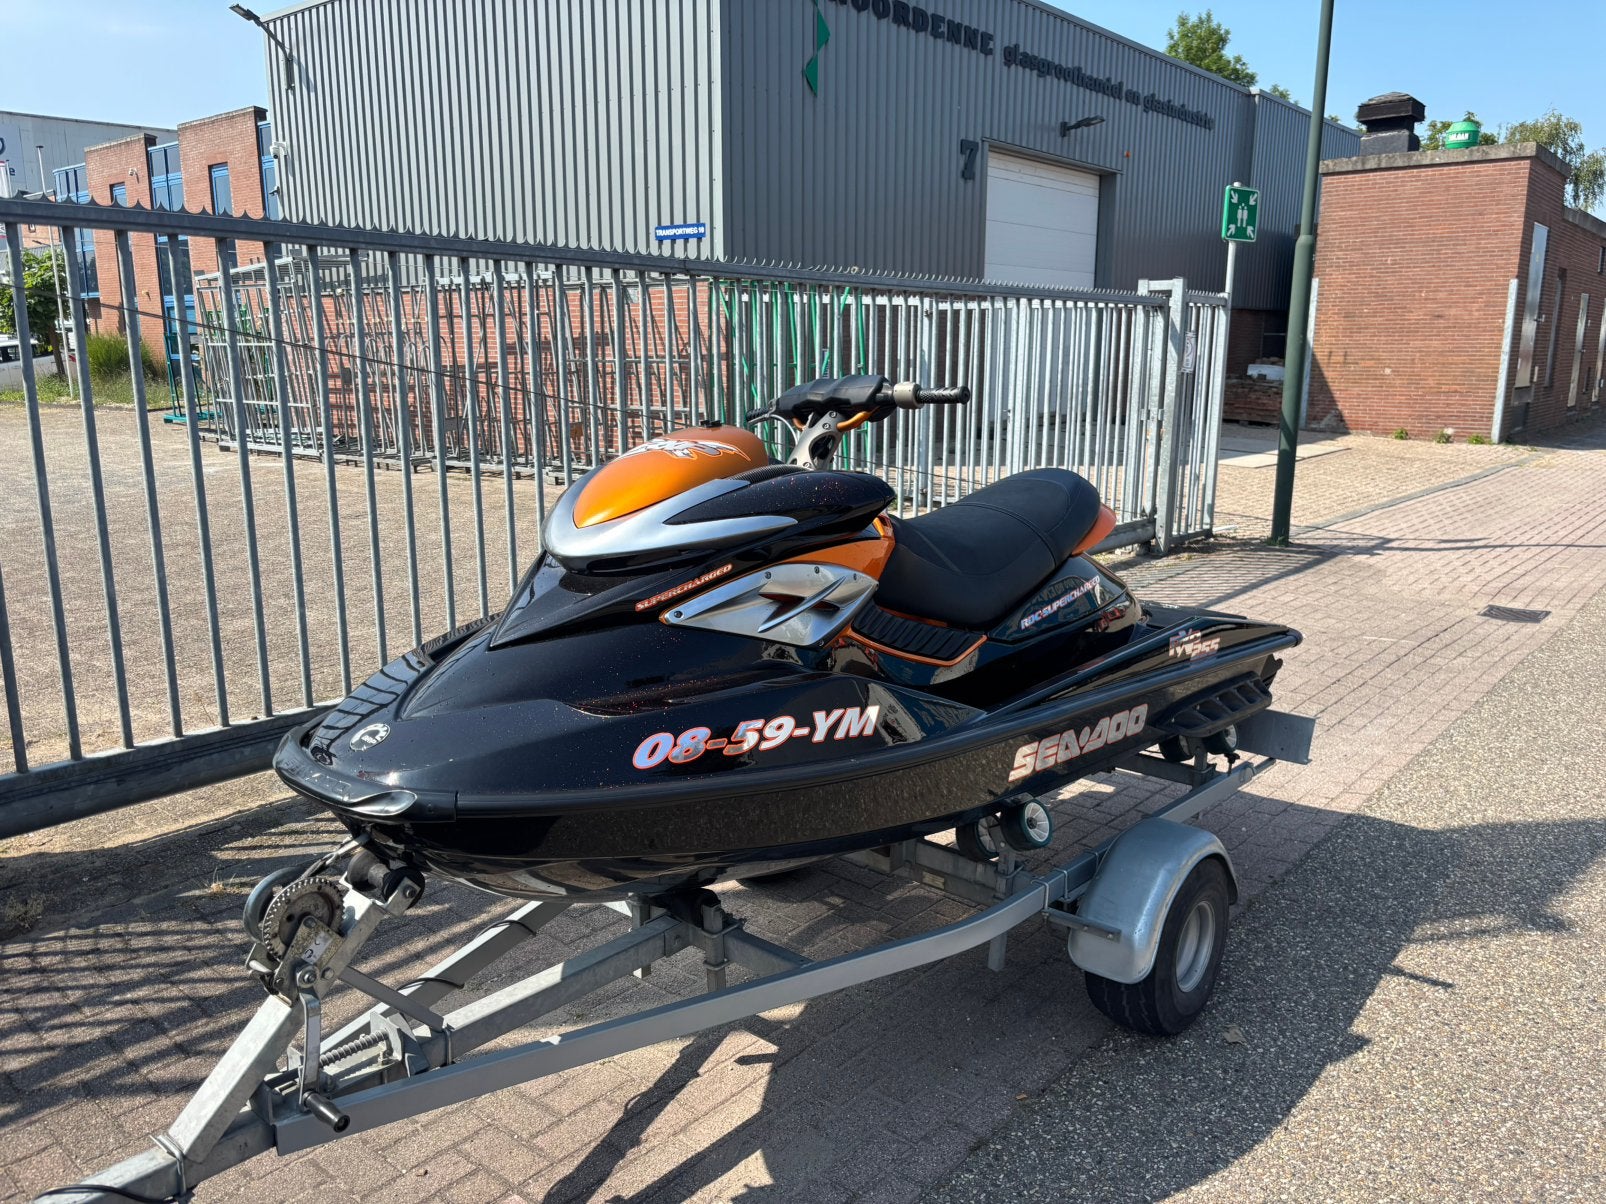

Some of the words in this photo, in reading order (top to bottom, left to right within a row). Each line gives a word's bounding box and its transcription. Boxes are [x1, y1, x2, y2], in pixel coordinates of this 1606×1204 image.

[1002, 43, 1124, 100] glasgroothandel
[1125, 88, 1141, 106] en
[960, 139, 979, 181] 7
[635, 563, 733, 612] SUPERCHARGED
[632, 705, 880, 770] 08-59-YM
